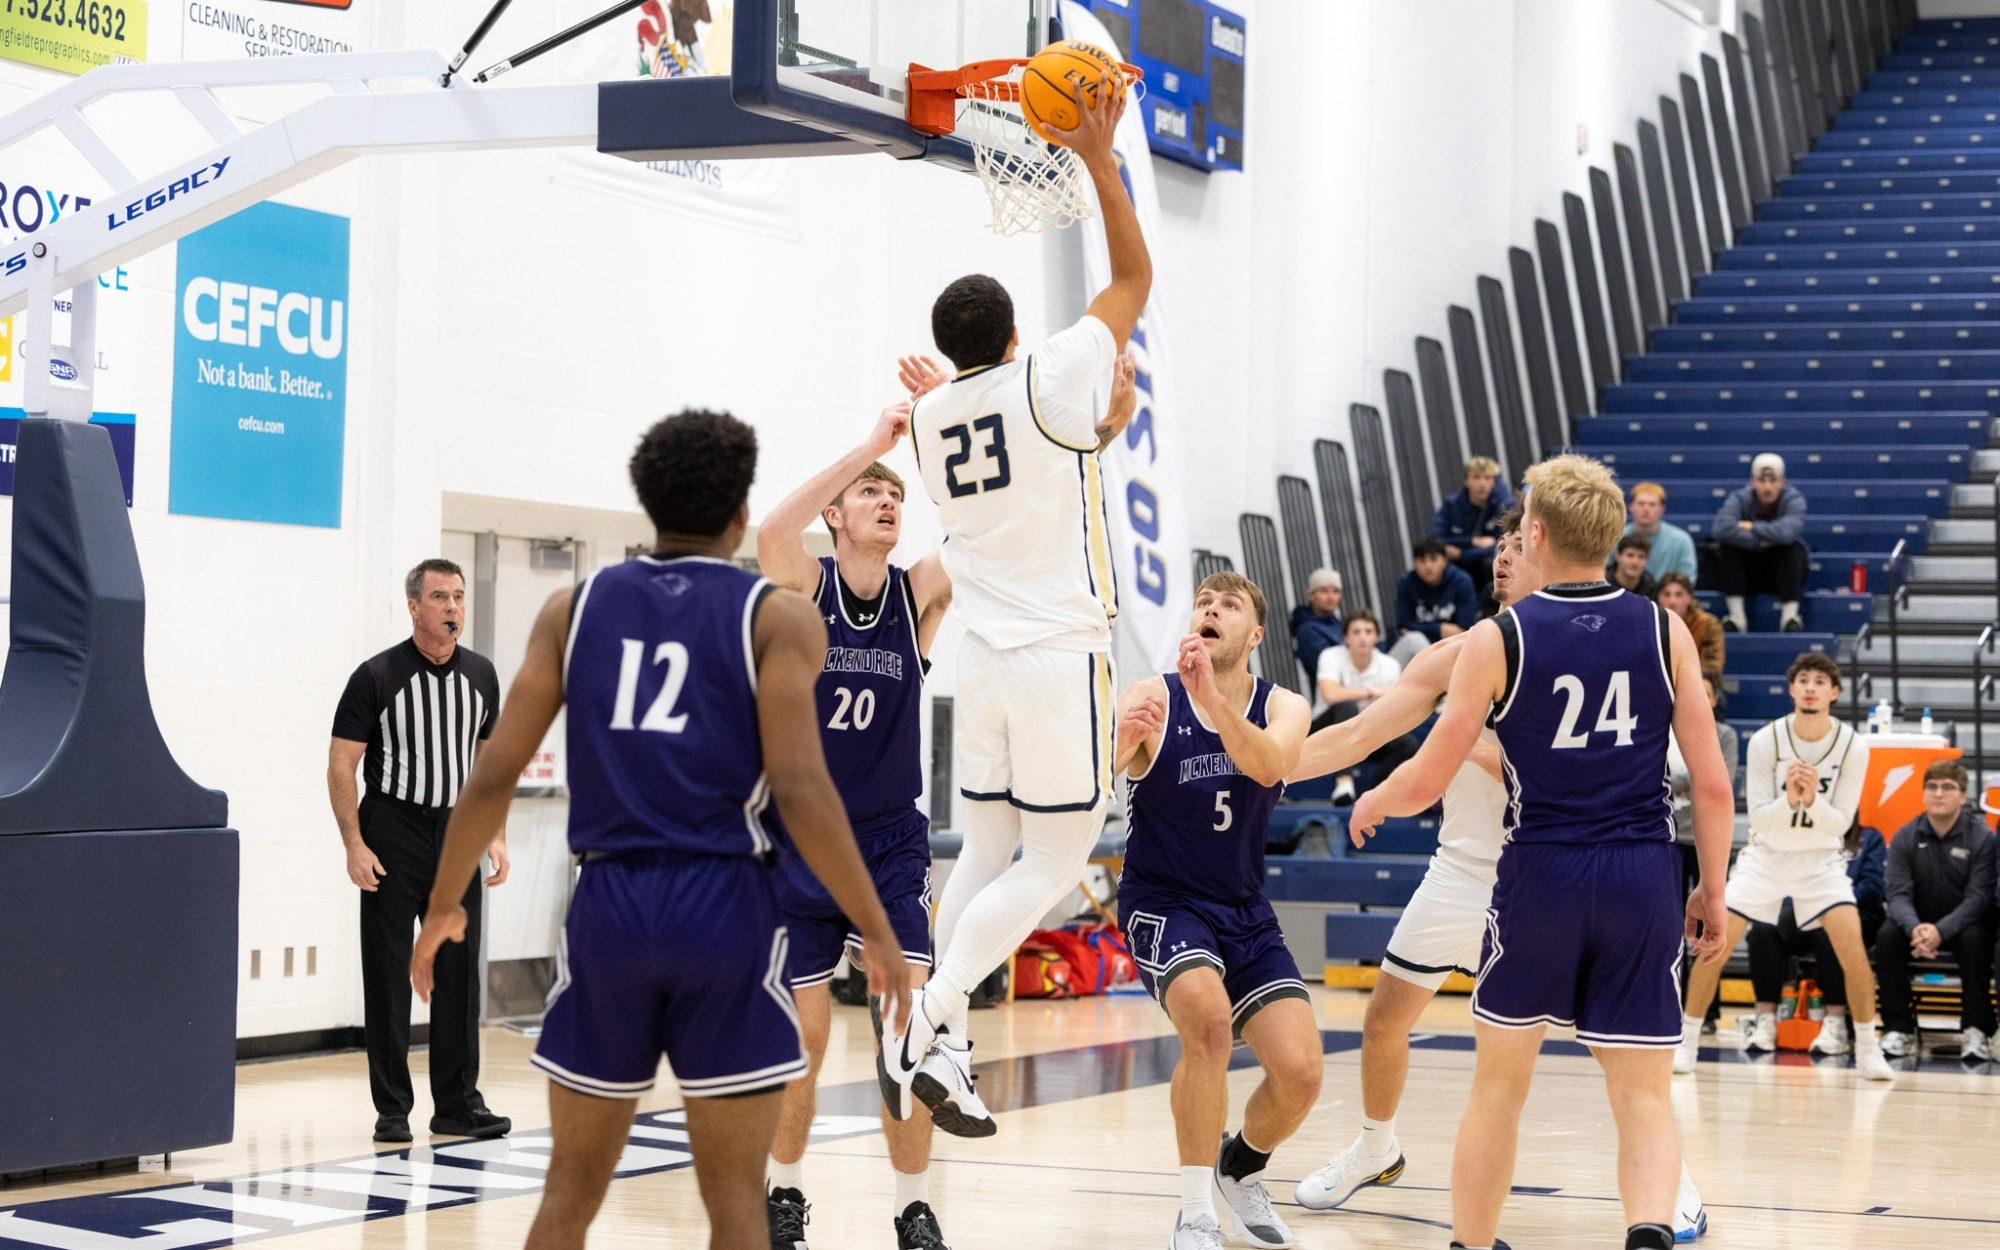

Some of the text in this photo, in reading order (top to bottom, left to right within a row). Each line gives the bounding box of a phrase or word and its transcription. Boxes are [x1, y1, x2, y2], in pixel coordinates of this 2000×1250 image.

[189, 3, 255, 37] CLEANING
[258, 24, 268, 40] &
[108, 156, 231, 231] LEGACY
[183, 276, 343, 359] CEFCU
[197, 358, 324, 400] Not a bank. Better.
[238, 416, 285, 435] cefcu.com
[939, 413, 1011, 499] 23
[1126, 478, 1168, 607] GO
[609, 638, 690, 734] 12
[820, 646, 903, 681] CKENDREE
[827, 686, 876, 731] 20
[1551, 670, 1639, 749] 24
[1178, 752, 1248, 785] MCKEN
[1213, 790, 1233, 832] 5
